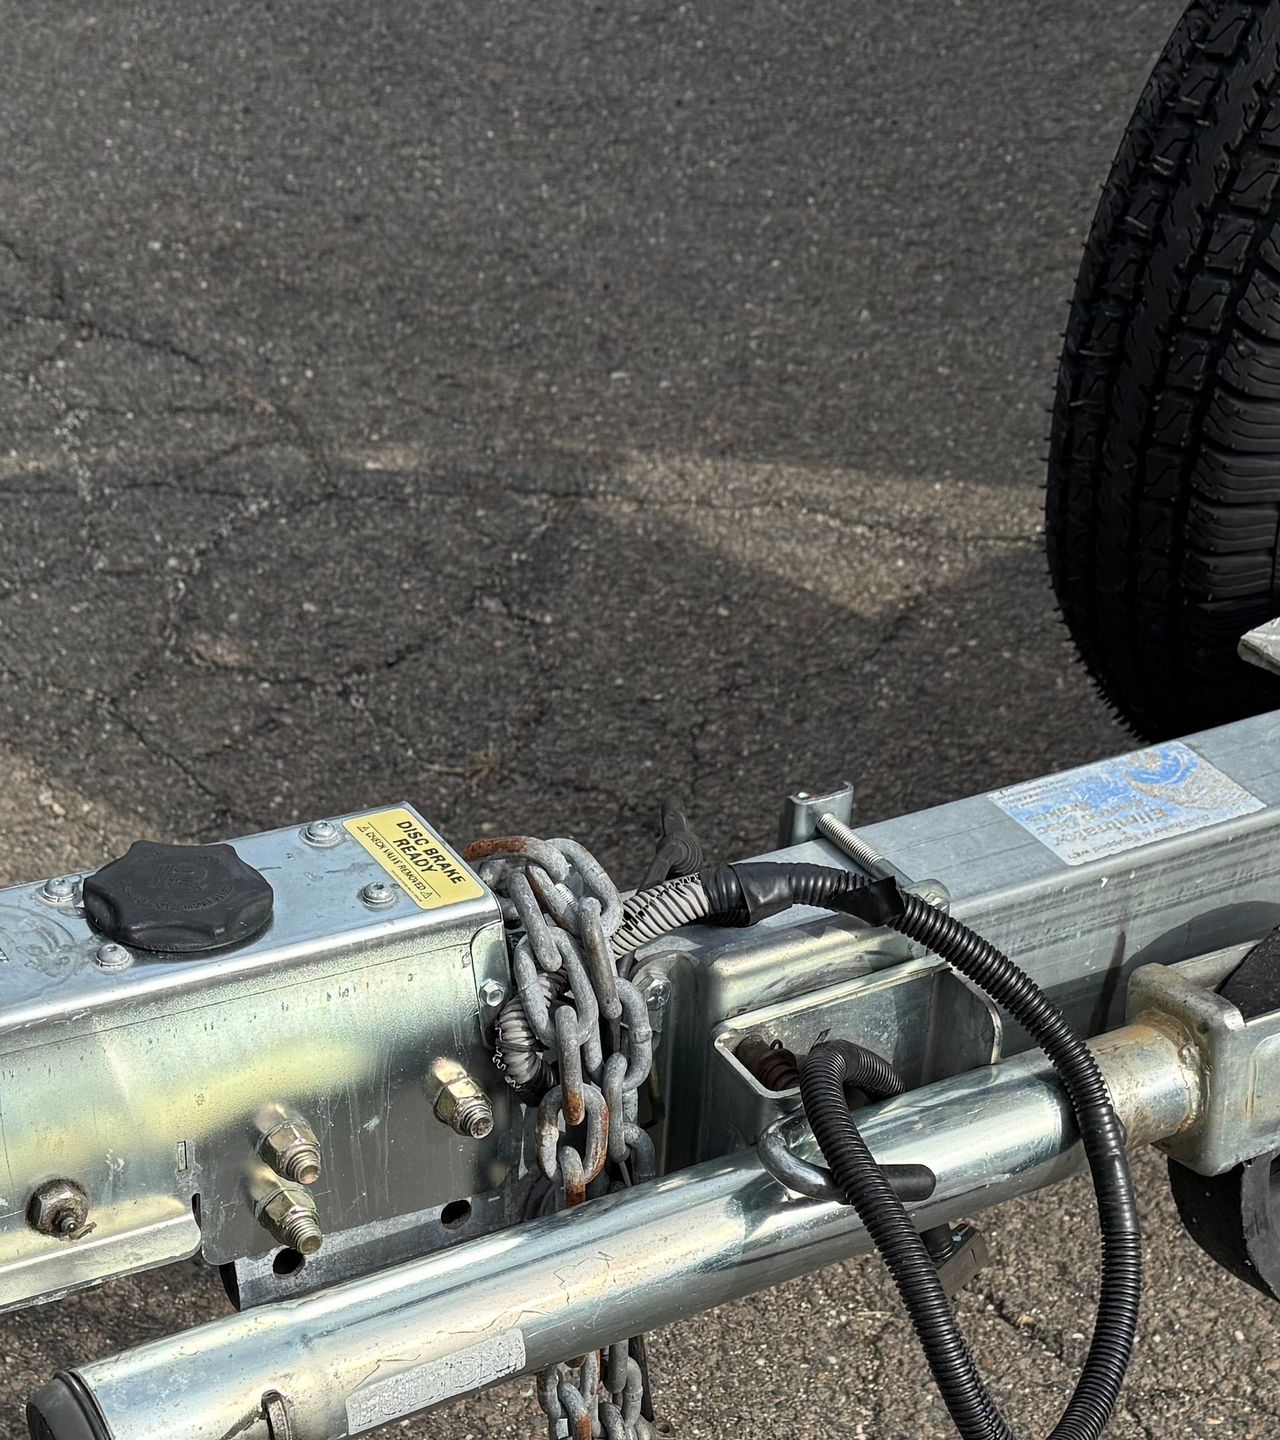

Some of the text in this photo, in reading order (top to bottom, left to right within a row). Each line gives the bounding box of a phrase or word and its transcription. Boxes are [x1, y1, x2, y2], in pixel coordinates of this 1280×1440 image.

[392, 839, 438, 873] READY
[396, 821, 466, 884] DISC BRAKE
[398, 864, 426, 890] REMOVED
